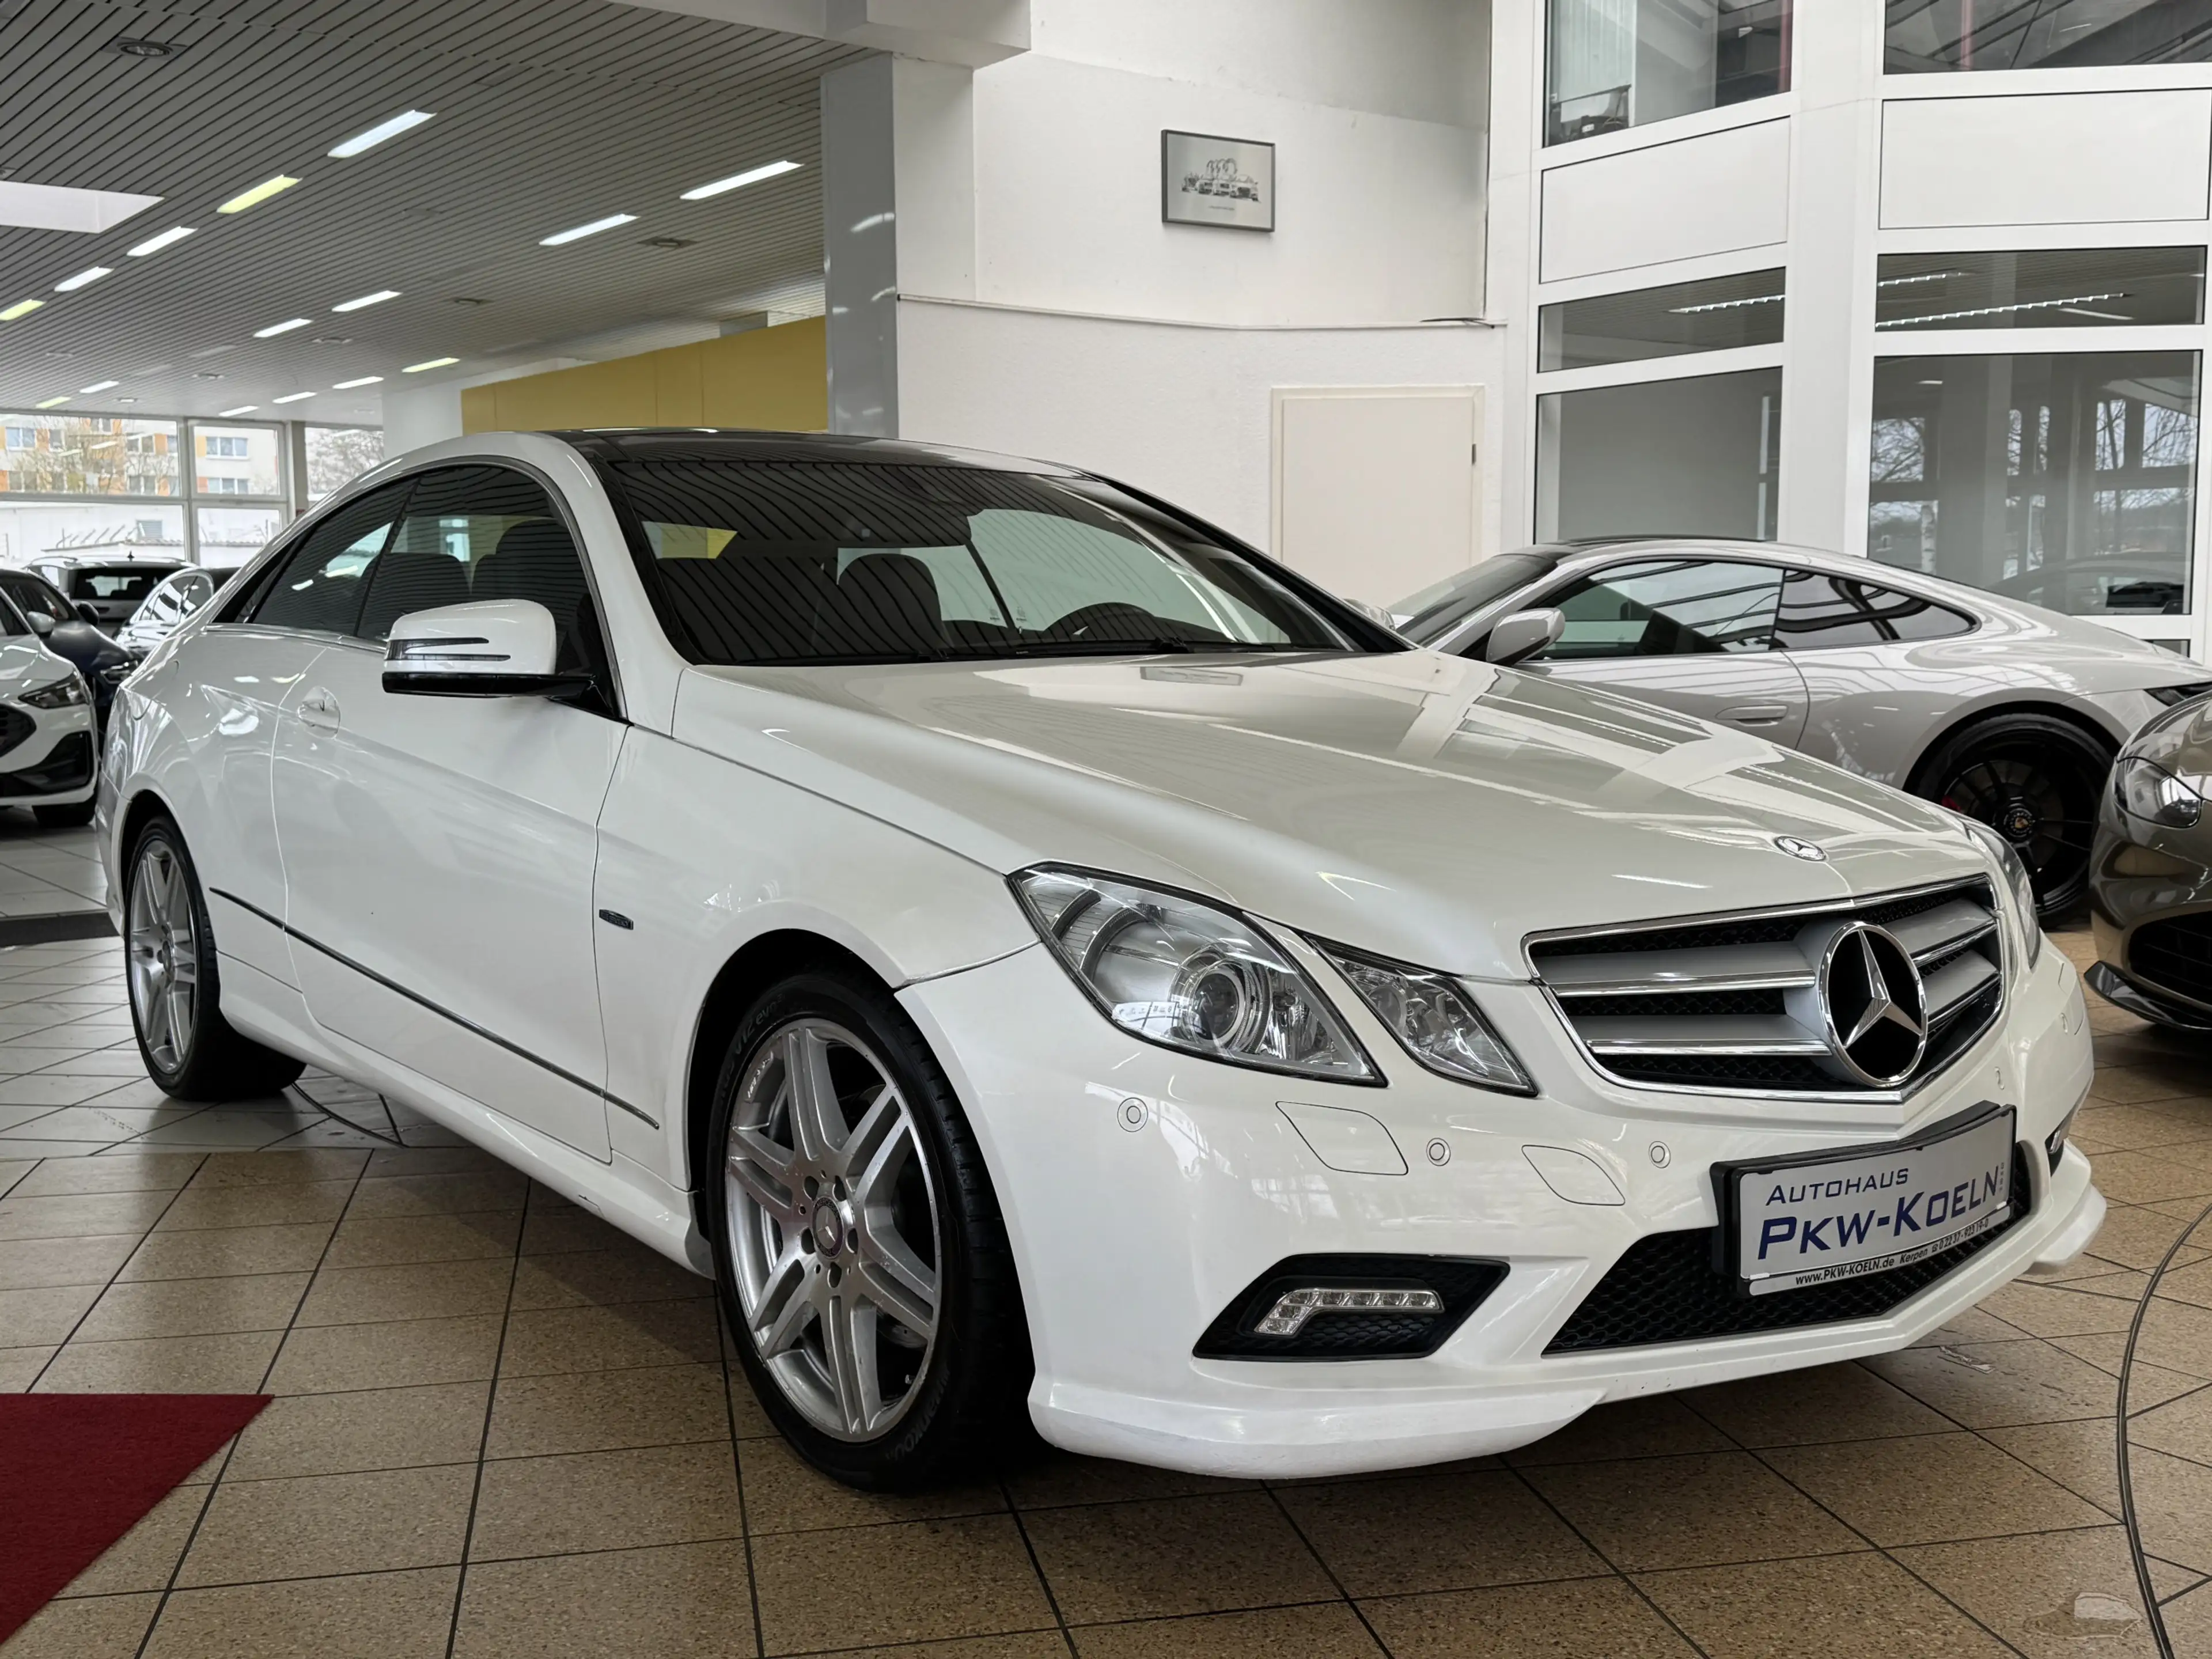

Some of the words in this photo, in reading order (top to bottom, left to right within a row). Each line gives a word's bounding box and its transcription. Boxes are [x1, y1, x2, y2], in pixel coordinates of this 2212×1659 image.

[1766, 1168, 1909, 1206] AUTOHAUS
[1758, 1166, 1999, 1260] PKW-KOELN
[1796, 1257, 1895, 1285] www.PKW-KOELN.de
[1900, 1248, 1928, 1264] Kerpen
